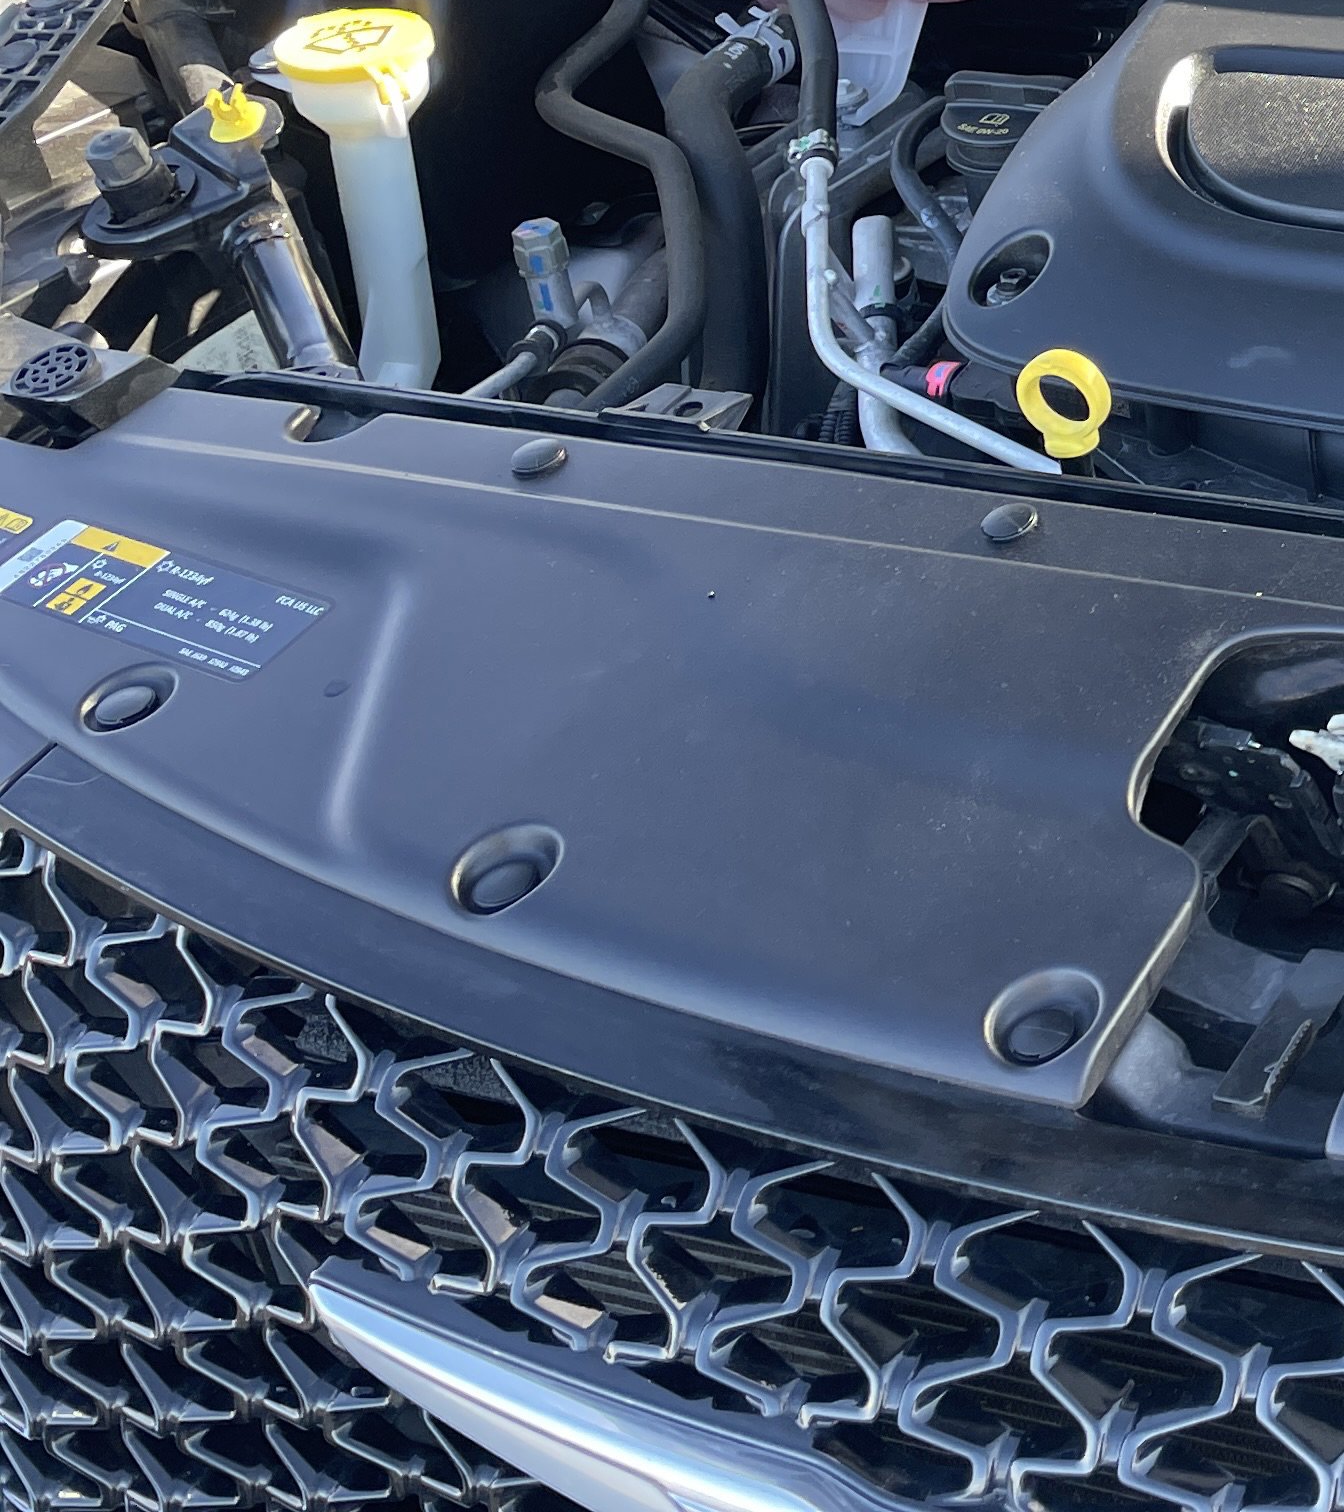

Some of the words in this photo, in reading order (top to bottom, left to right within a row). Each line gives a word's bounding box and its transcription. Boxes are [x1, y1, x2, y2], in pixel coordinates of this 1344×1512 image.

[169, 566, 213, 585] R-1234yf
[162, 589, 192, 603] SINGLE
[188, 598, 207, 608] A/C
[275, 595, 295, 606] FCA
[293, 600, 308, 610] US
[305, 605, 324, 615] LLC
[154, 602, 176, 614] DUAL
[174, 609, 193, 619] A/C
[104, 620, 126, 632] PAG
